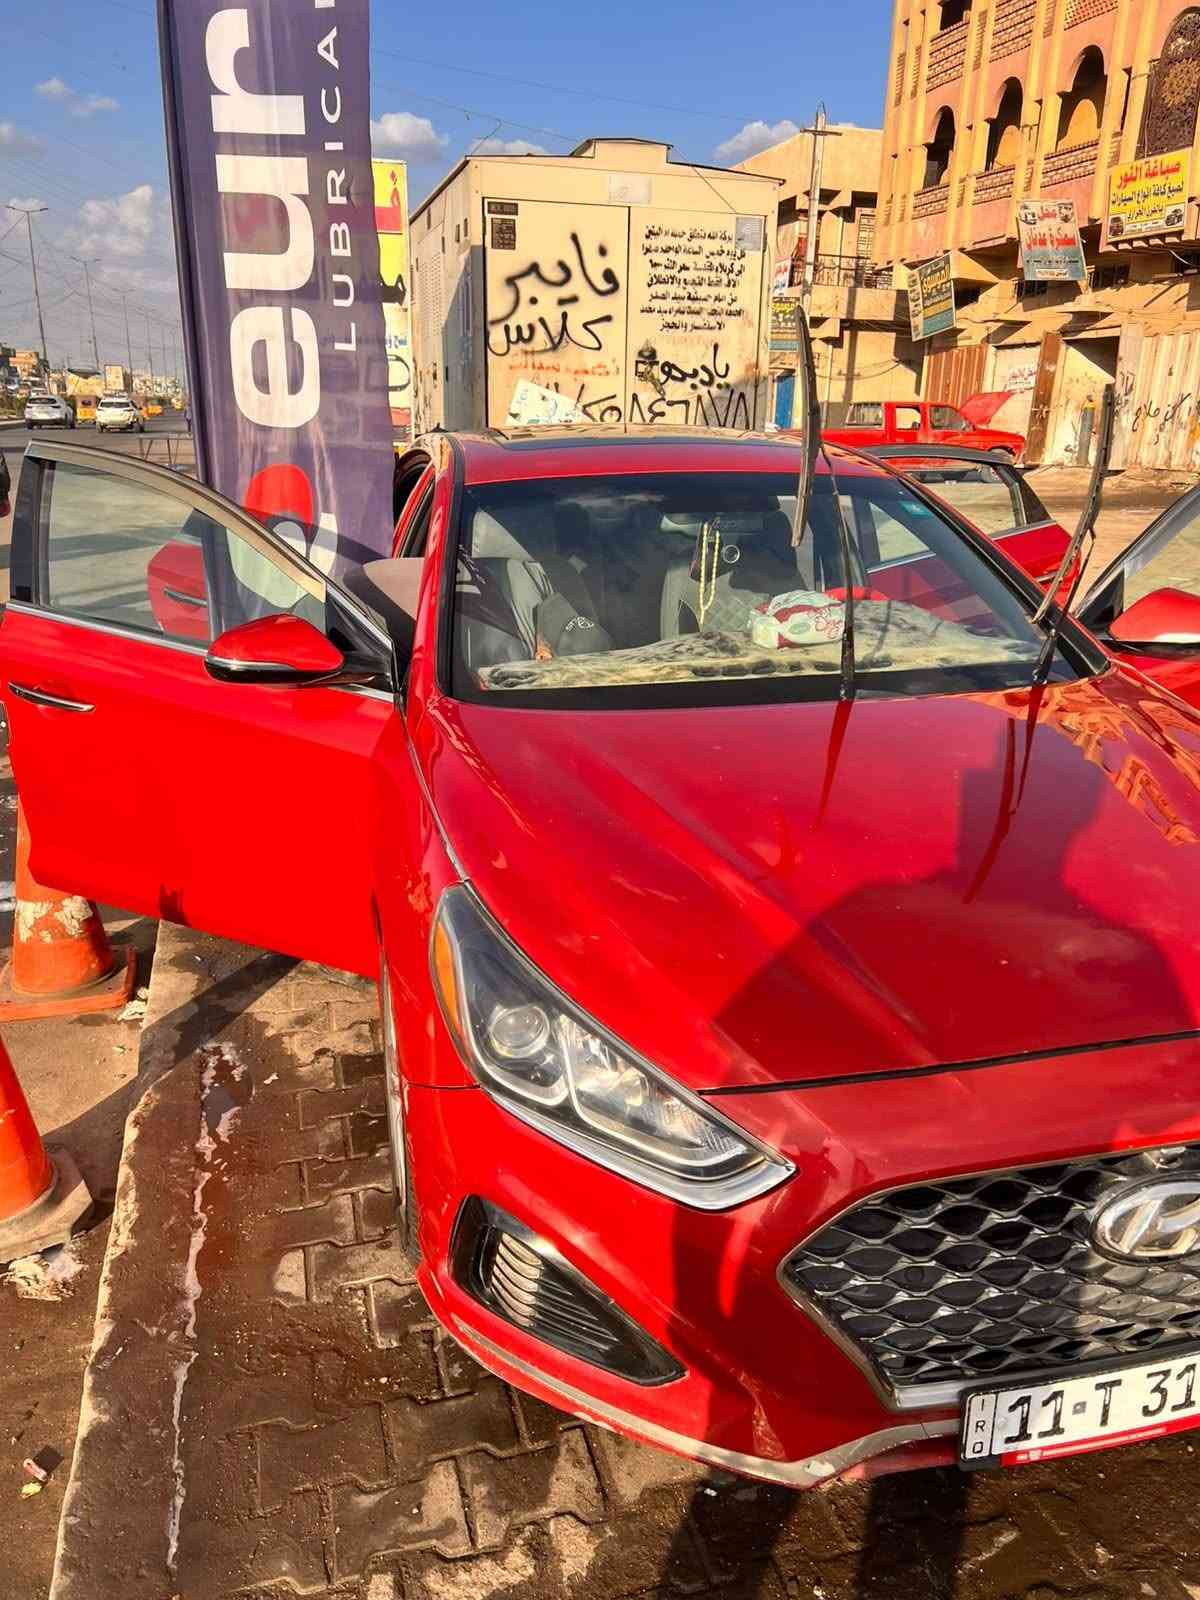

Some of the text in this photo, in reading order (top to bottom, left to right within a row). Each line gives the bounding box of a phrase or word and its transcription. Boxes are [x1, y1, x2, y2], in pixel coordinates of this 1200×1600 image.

[1004, 1390, 1065, 1445] 11
[1095, 1378, 1122, 1427] T
[1142, 1363, 1197, 1418] 31
